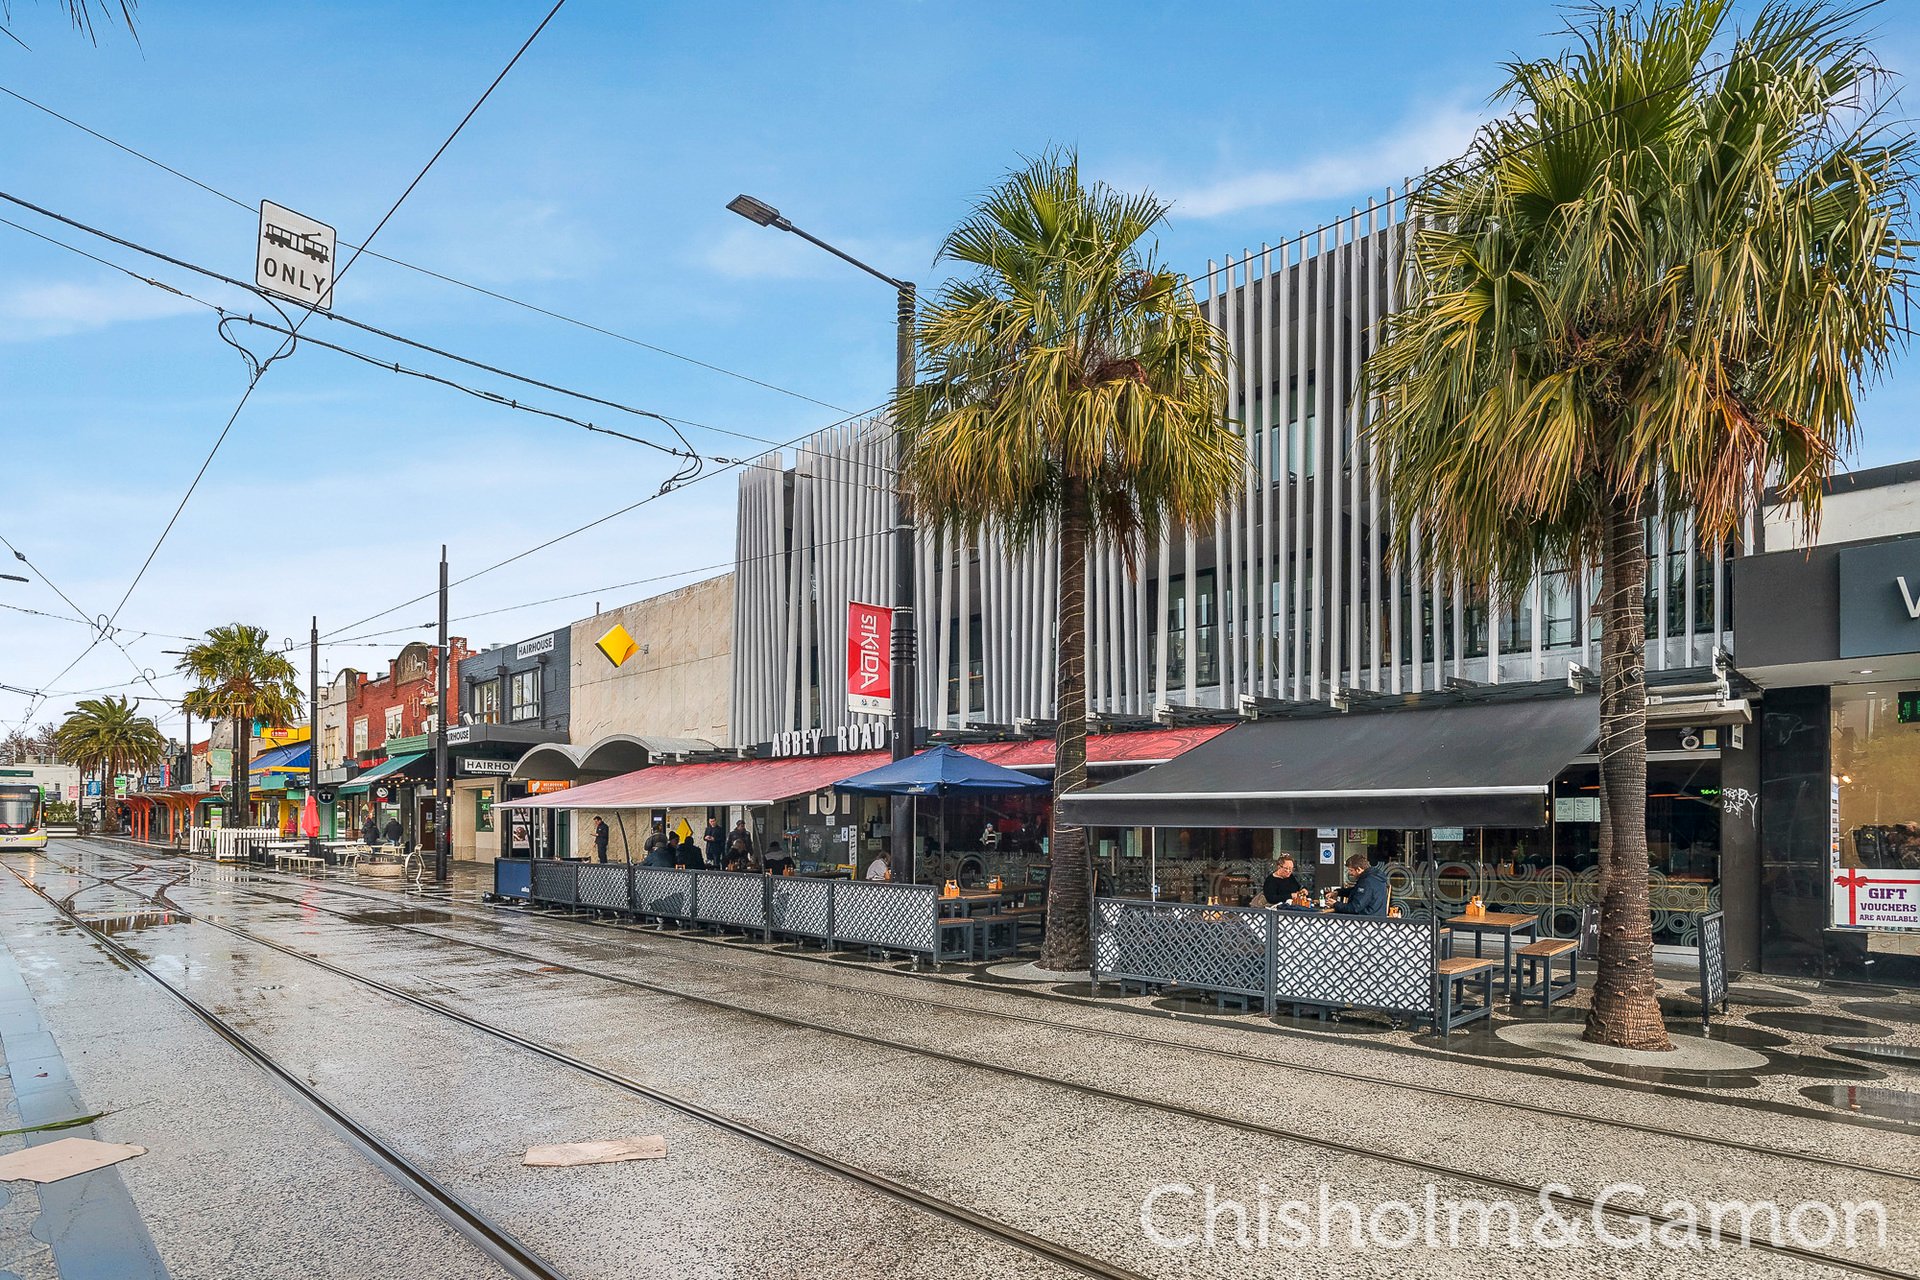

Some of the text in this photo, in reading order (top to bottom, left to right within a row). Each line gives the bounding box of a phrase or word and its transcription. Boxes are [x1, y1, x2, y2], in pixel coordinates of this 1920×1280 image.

[263, 257, 326, 295] ONLY
[518, 637, 553, 657] HAIRHOUSE
[448, 729, 469, 743] IRHOUSE
[771, 721, 886, 758] ABBEY ROAD
[467, 761, 517, 771] HAIRHOU
[1868, 887, 1908, 900] GIFT
[1859, 902, 1918, 913] VOUCHERS
[1859, 913, 1919, 923] ARE AVAILABLE
